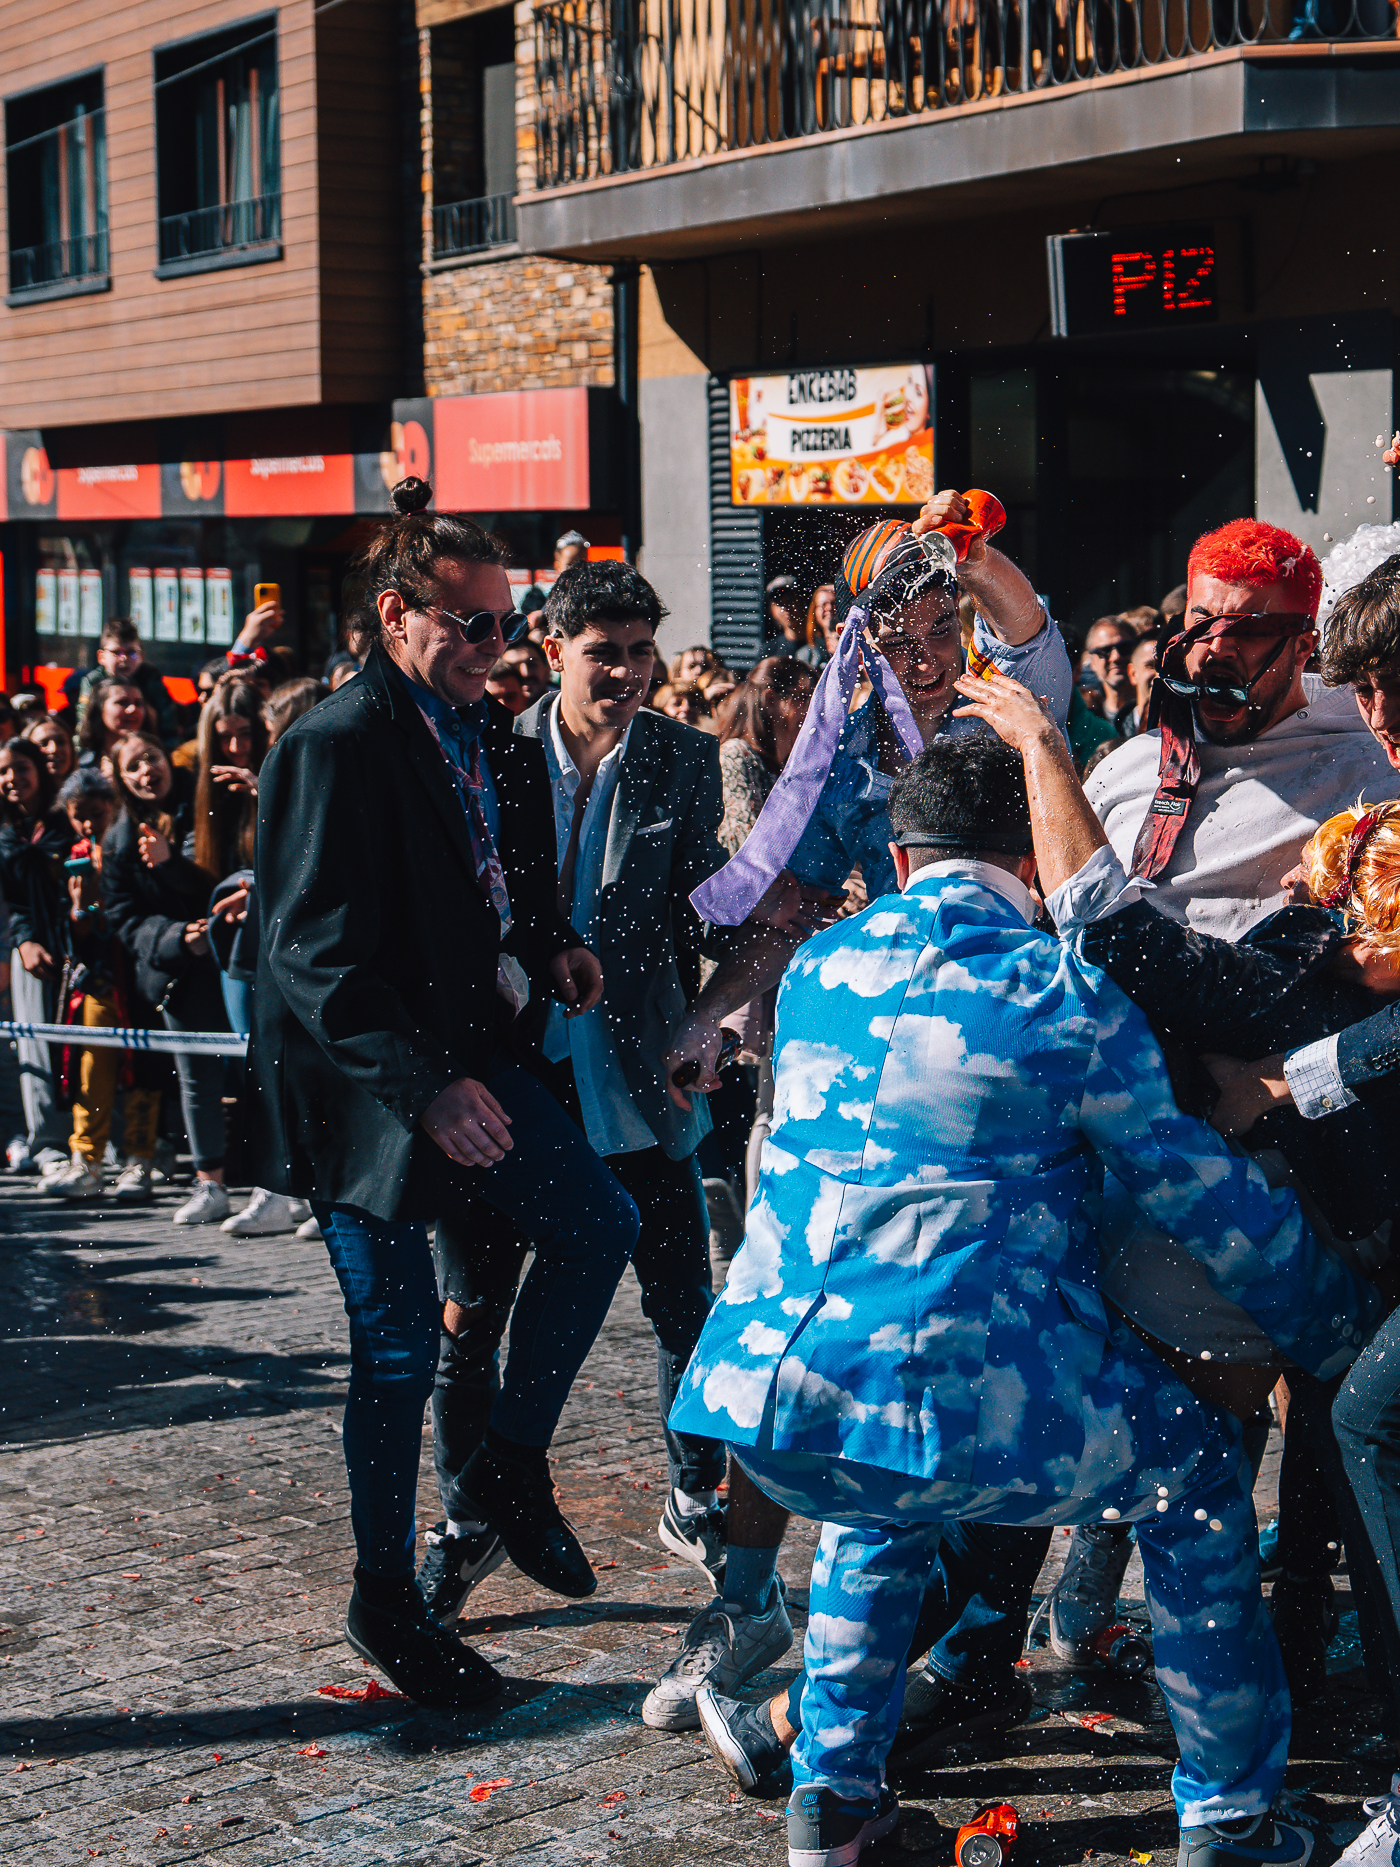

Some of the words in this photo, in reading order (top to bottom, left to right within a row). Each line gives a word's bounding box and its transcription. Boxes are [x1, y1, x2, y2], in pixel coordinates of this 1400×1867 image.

[1112, 248, 1214, 315] PIZ
[468, 432, 563, 469] Supermercats
[791, 426, 852, 453] PIZZERIA
